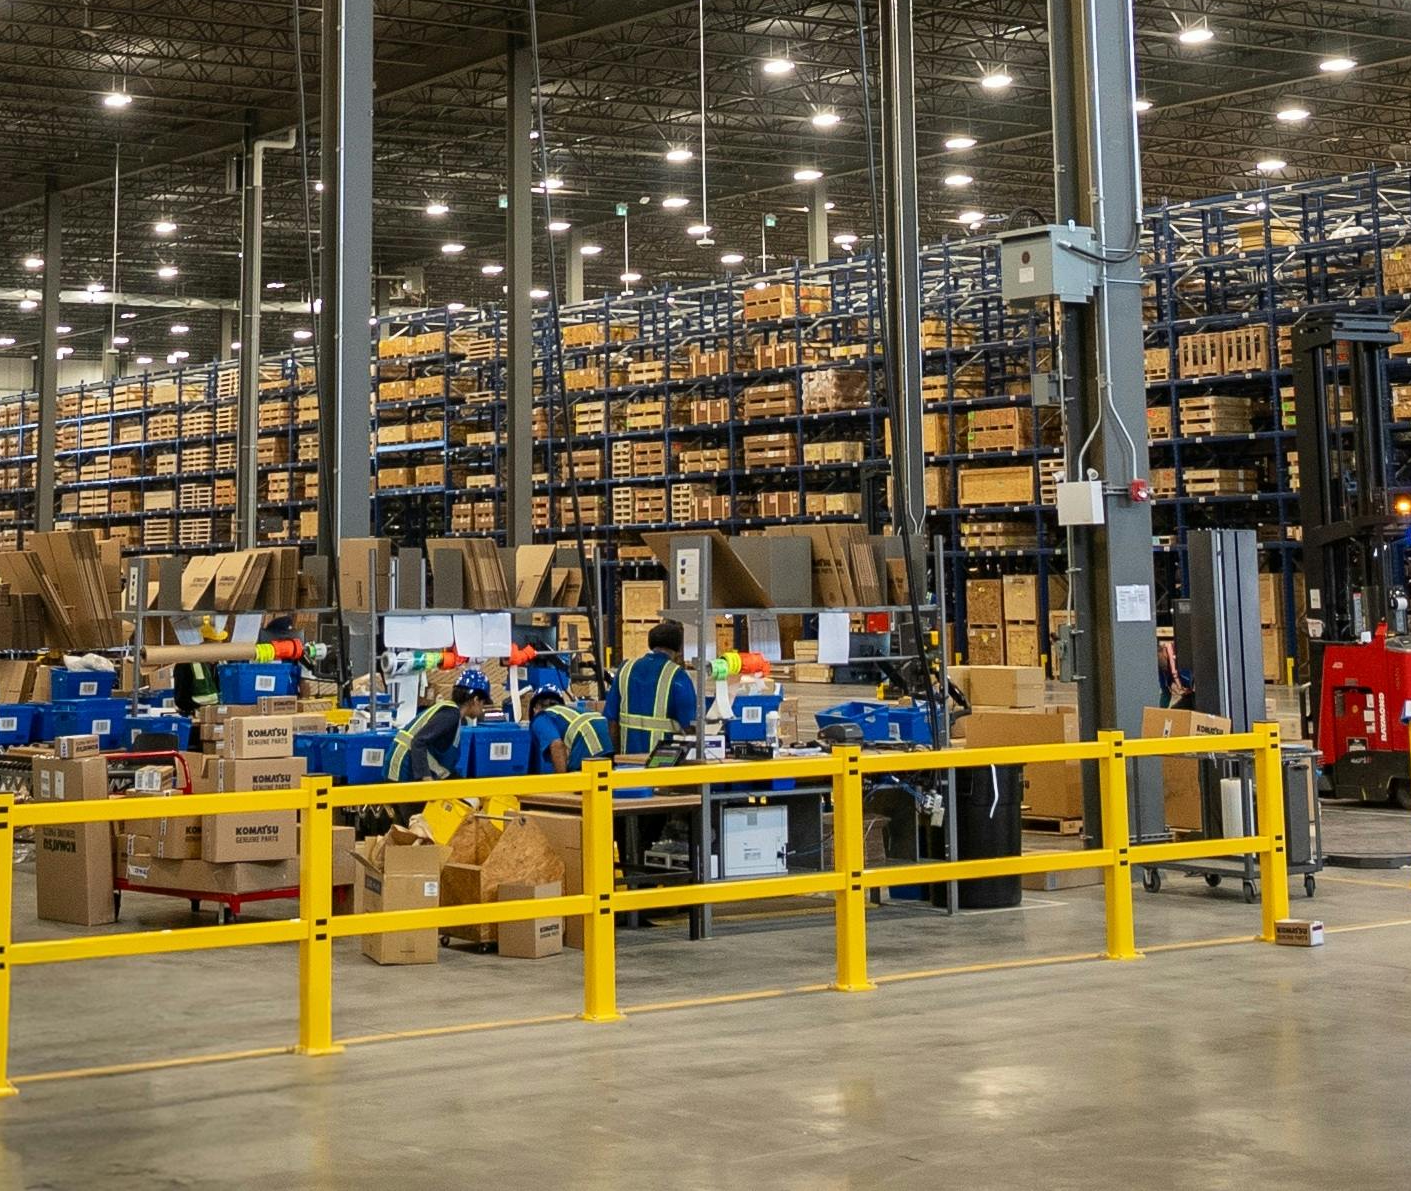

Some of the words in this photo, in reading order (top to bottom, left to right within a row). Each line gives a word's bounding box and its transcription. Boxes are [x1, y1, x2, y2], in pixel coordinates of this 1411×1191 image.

[1378, 692, 1387, 741] RAYMOND
[247, 727, 288, 738] KOMATSU
[247, 738, 269, 746] GENUINE
[271, 737, 288, 745] PARTS
[252, 773, 291, 784] KOMATSU
[235, 824, 279, 836] KOMATSU
[235, 836, 259, 844] GENUINE
[260, 835, 279, 843] PARTS
[43, 838, 76, 853] KOMATSU
